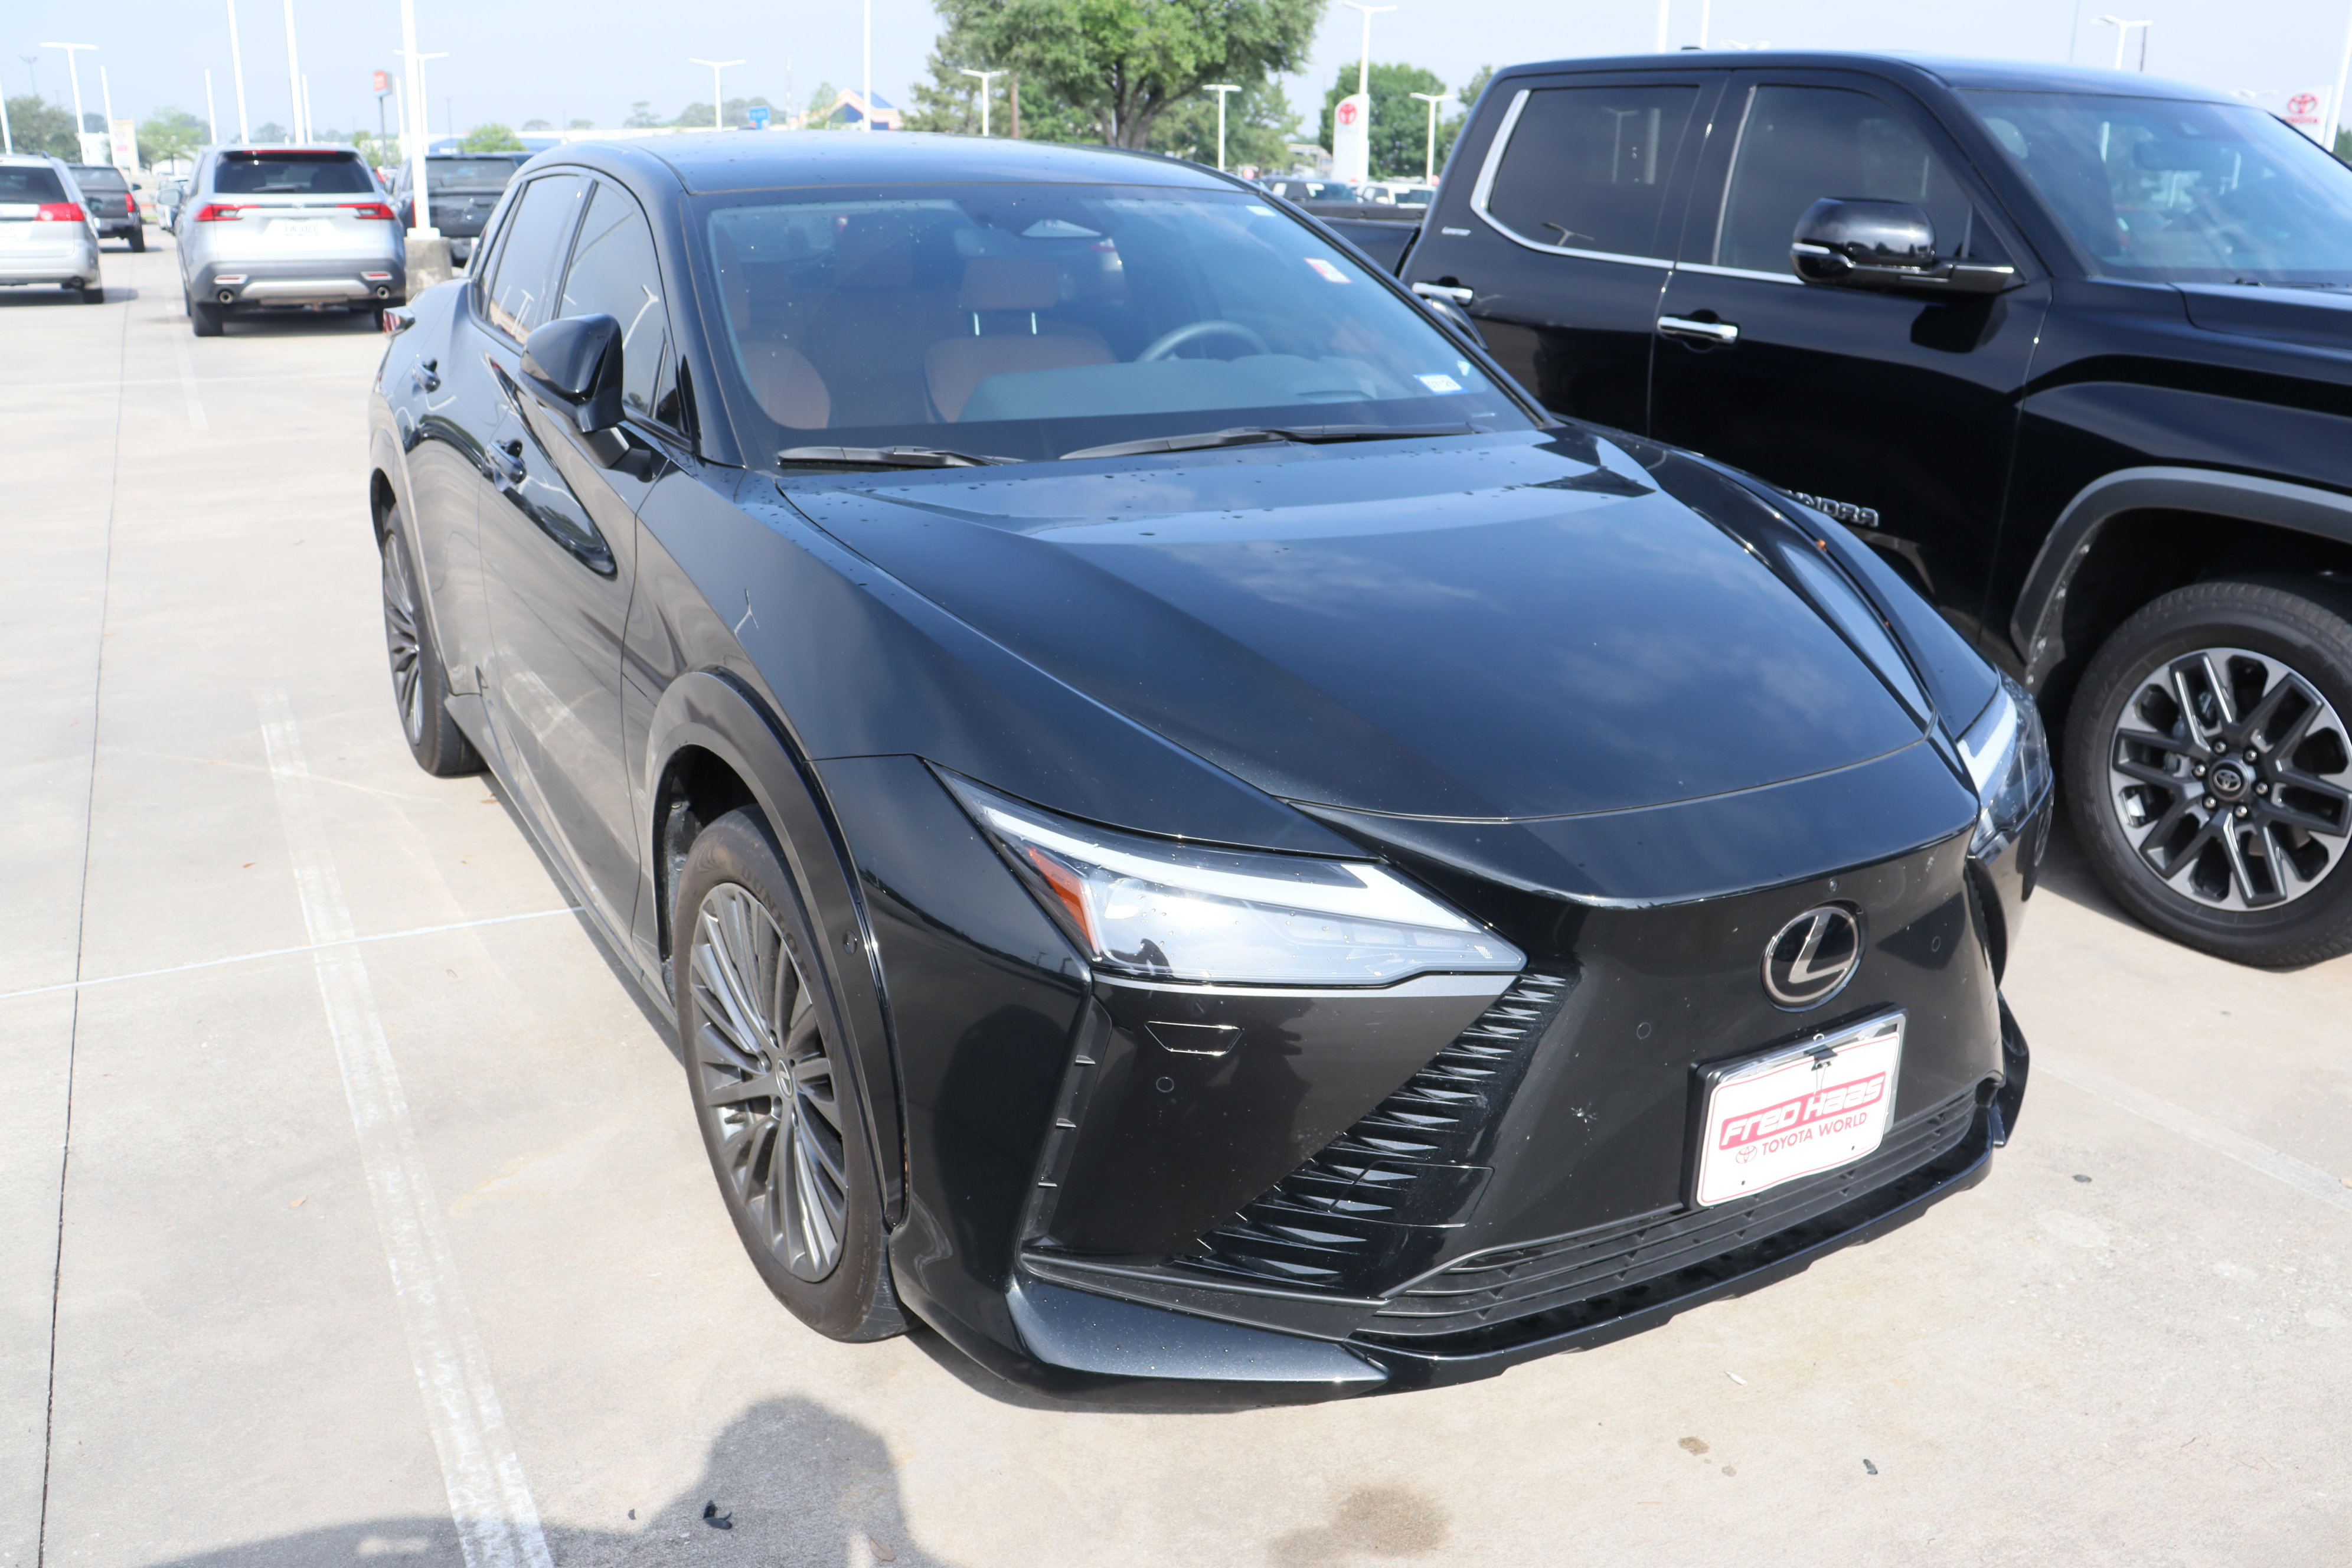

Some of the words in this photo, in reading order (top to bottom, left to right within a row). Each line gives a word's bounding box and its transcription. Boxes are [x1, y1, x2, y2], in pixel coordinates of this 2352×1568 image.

[1787, 489, 1879, 528] NDRA
[1762, 1128, 1812, 1155] TOYOTA
[1819, 1112, 1867, 1136] WORLD
